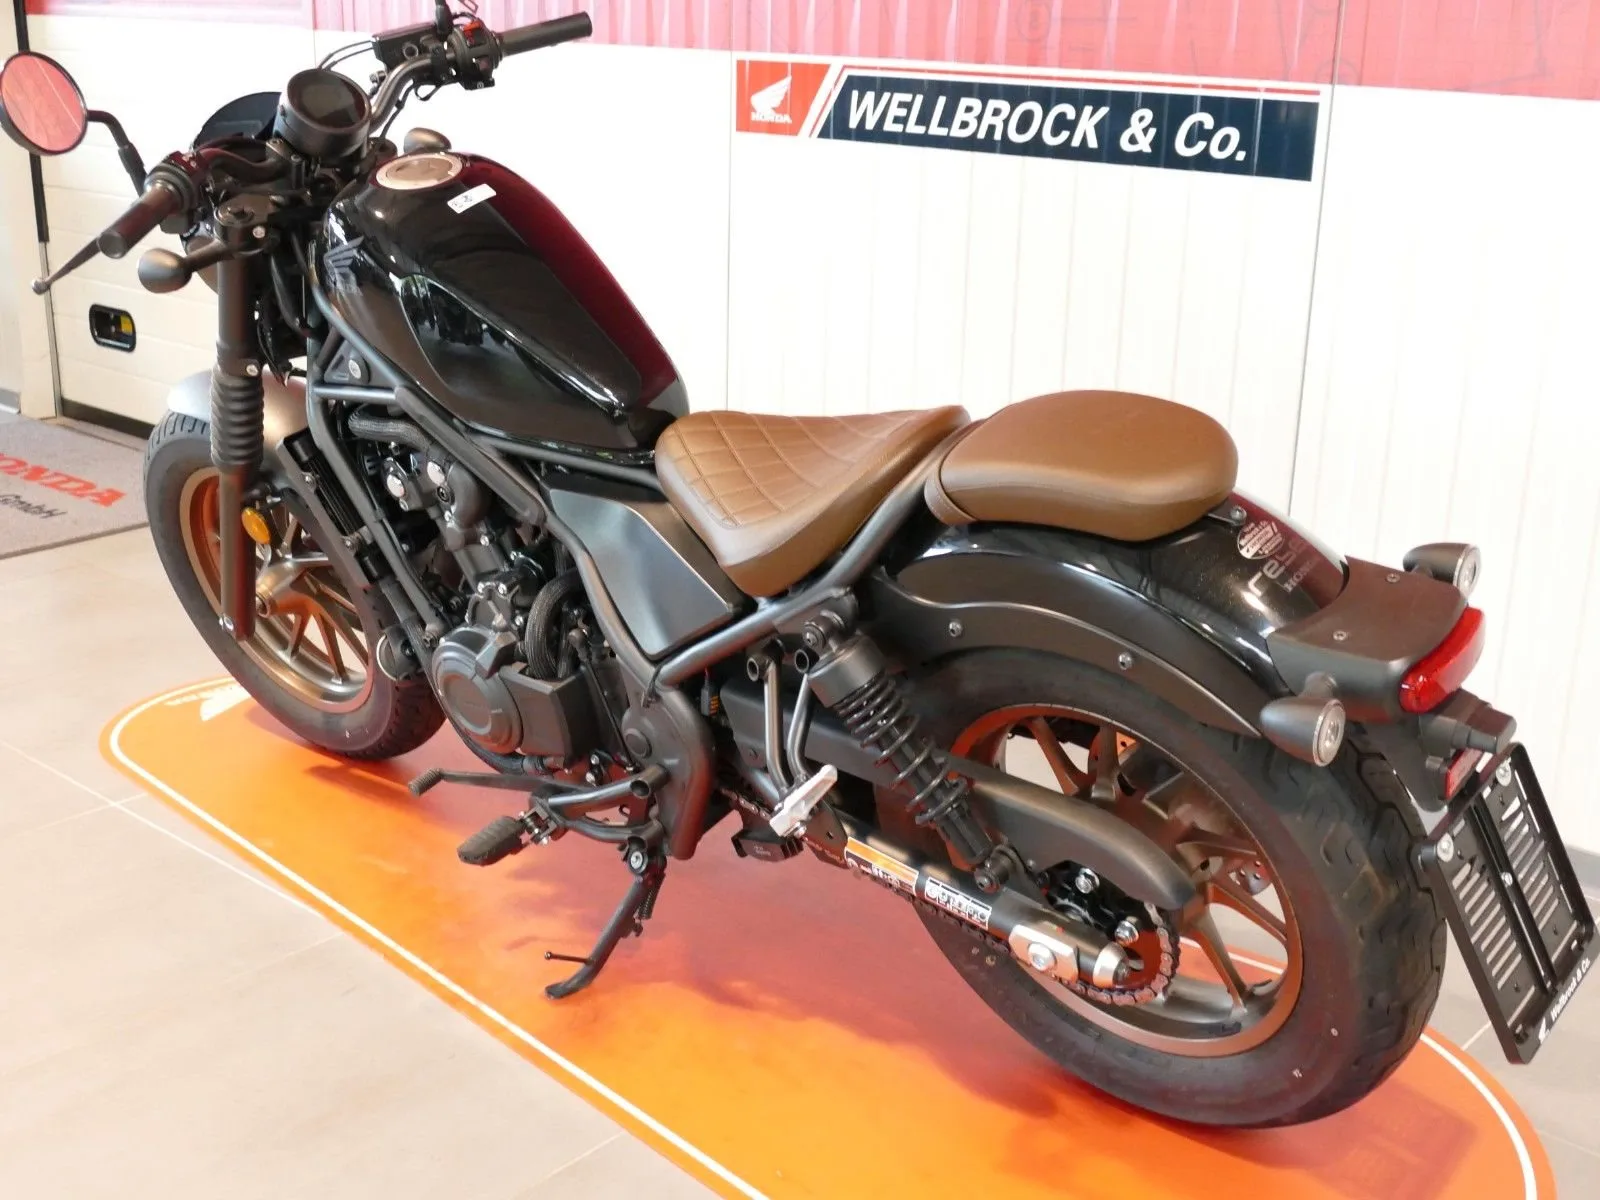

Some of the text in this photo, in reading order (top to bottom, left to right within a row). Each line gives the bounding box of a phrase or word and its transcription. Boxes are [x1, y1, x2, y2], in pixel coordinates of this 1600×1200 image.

[849, 89, 1246, 161] WELLBROCK & Co.
[0, 455, 126, 507] ONDA
